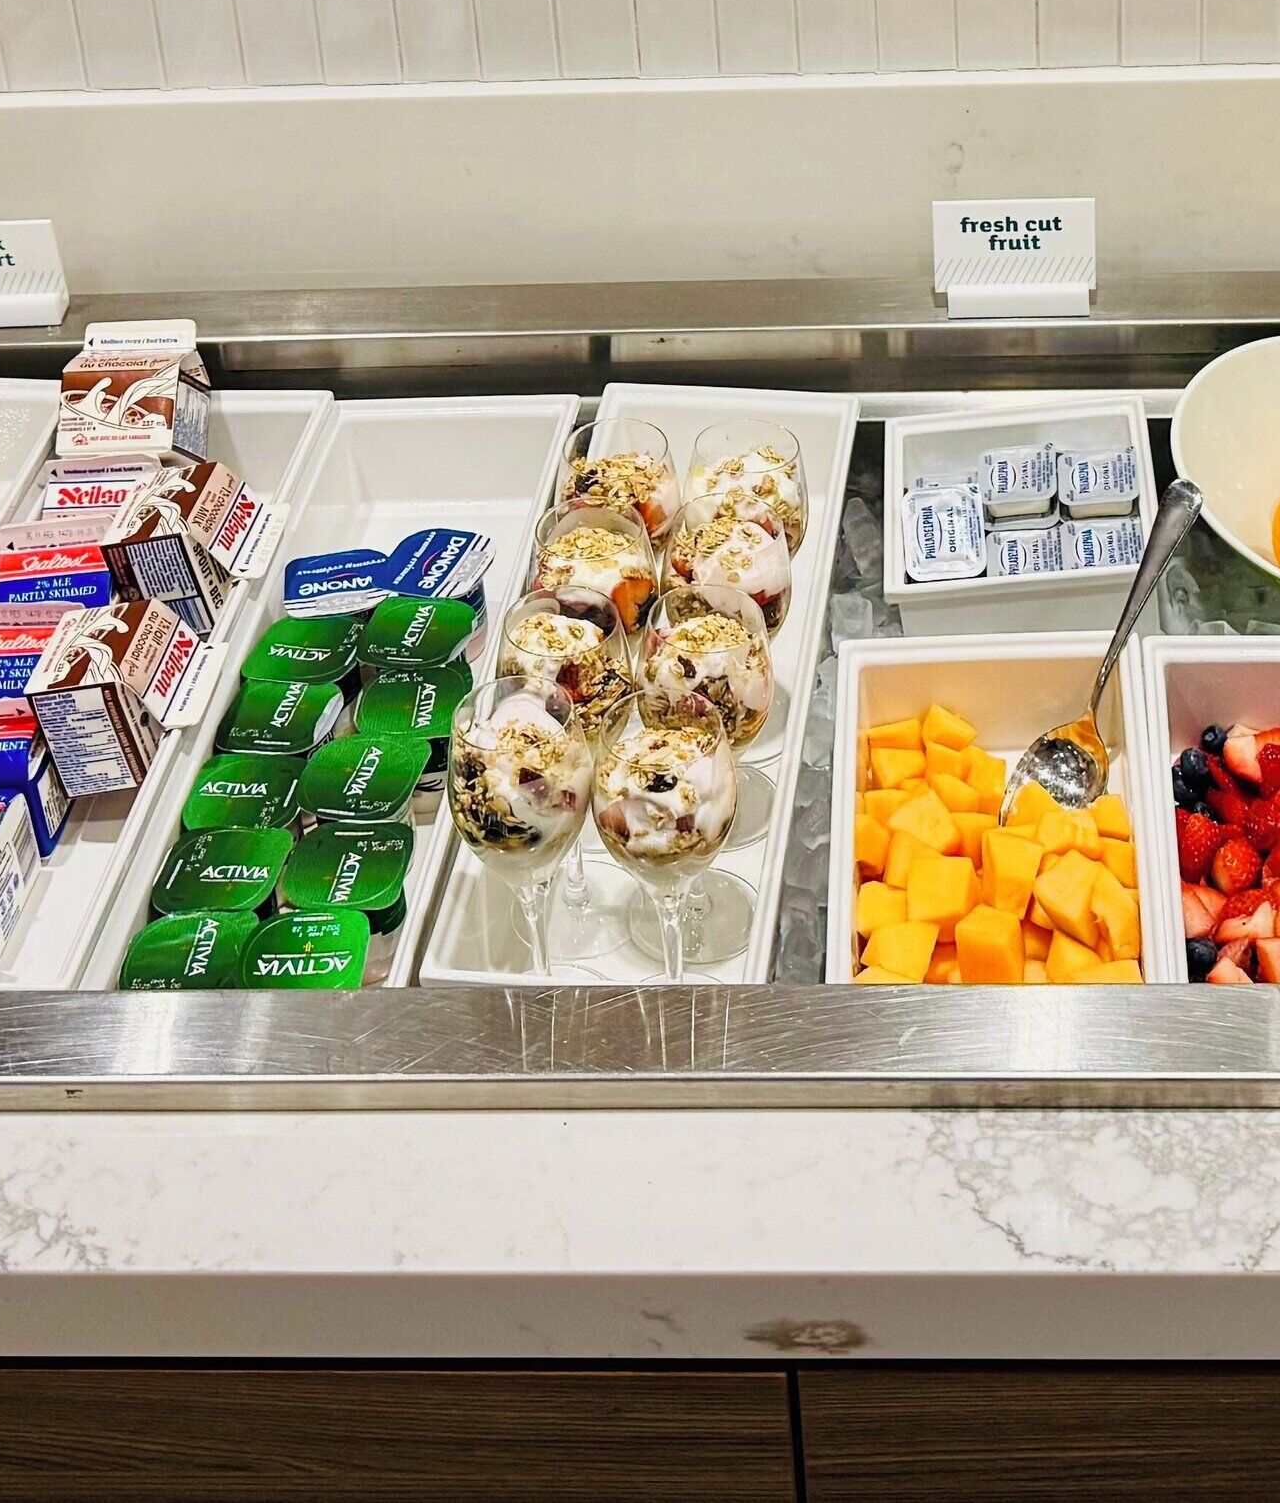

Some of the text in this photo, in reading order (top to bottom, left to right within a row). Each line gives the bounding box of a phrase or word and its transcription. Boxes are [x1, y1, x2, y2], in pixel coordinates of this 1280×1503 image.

[960, 216, 1063, 233] fresh cut
[988, 234, 1041, 251] fruit
[57, 485, 129, 507] Neilso
[923, 505, 937, 559] PHILADELPHIA
[947, 506, 956, 554] ORIGINAL
[21, 553, 90, 571] Sealtest
[192, 542, 225, 610] SPOUT BEC
[8, 585, 98, 603] PARTLY SKIMMED
[35, 579, 51, 590] 2%
[148, 610, 160, 623] au
[401, 604, 434, 648] ACTIVIA
[130, 622, 153, 663] chocolat
[268, 647, 332, 662] ACTIVIA
[153, 630, 194, 698] Neilson
[271, 683, 303, 728] ACTIVIA
[415, 683, 438, 729] ACTIVIA
[346, 746, 385, 796] ACTIVIA
[199, 781, 269, 795] ACTIVIA
[199, 864, 271, 879] ACTIVIA
[331, 851, 363, 903] ACTIVIA
[187, 917, 220, 977] ACTIVIA
[252, 957, 354, 976] ACTIVIA
